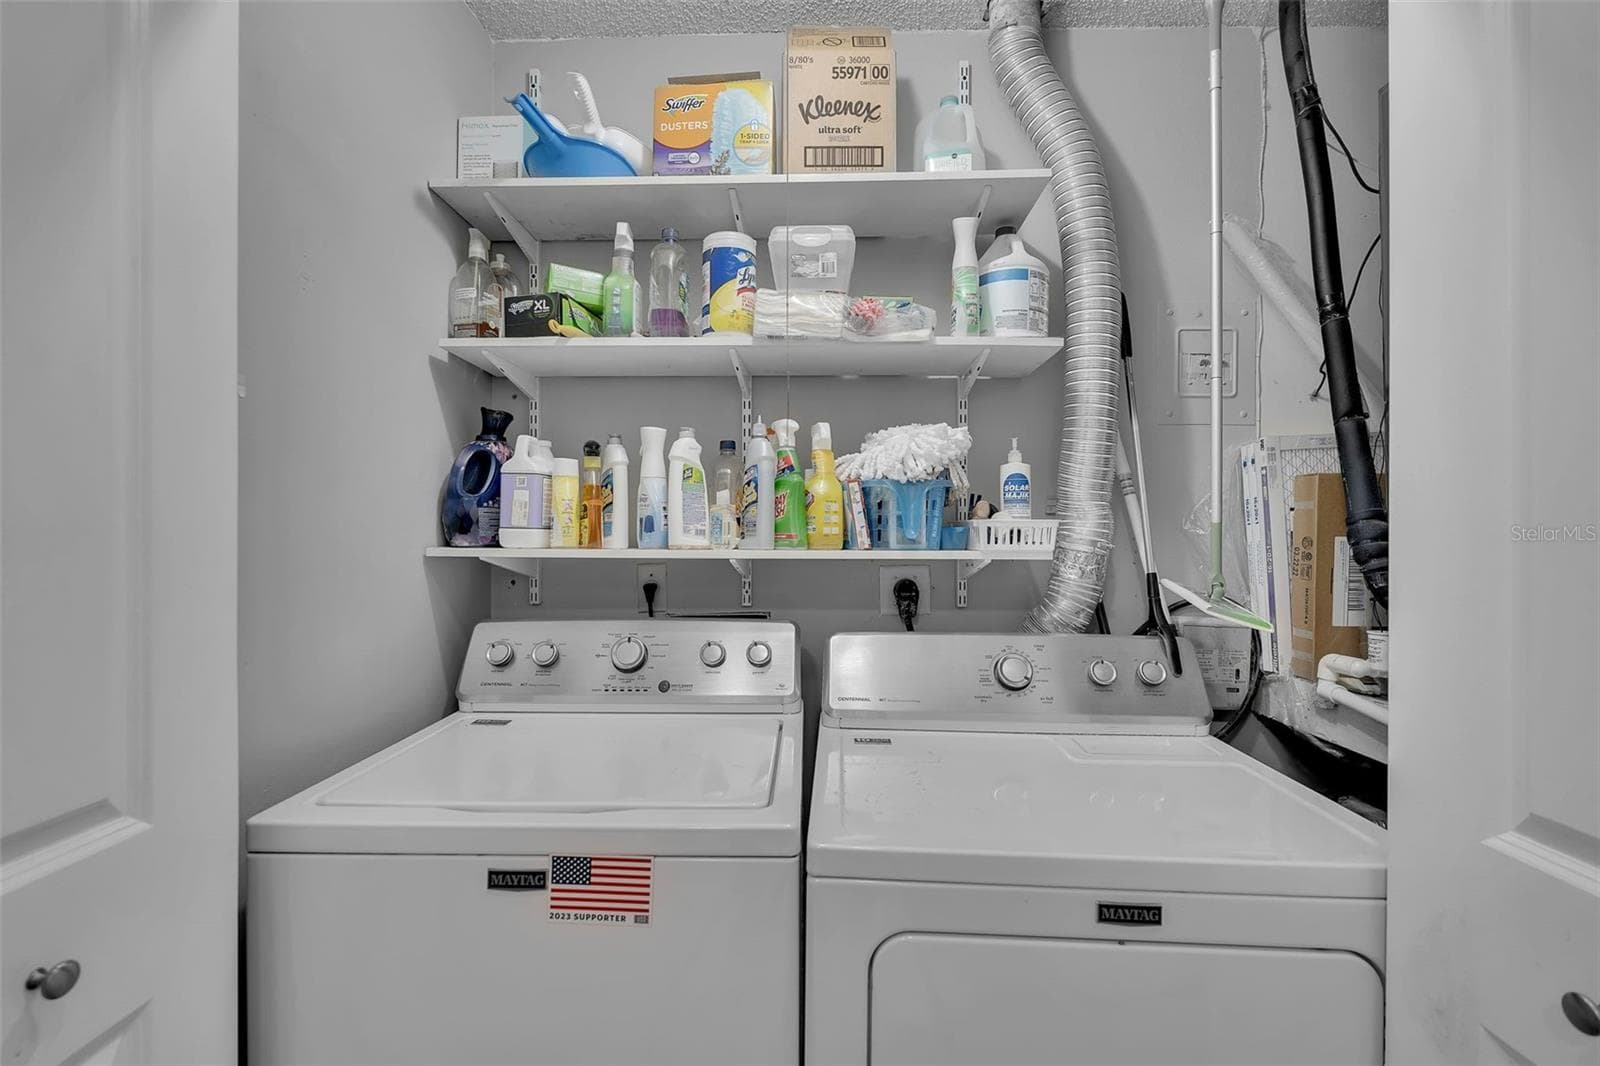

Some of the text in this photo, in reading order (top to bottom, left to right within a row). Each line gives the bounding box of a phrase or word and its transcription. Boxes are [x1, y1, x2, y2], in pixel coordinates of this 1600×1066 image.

[848, 56, 871, 64] 36000
[831, 66, 889, 80] 55971 00
[662, 97, 705, 113] Swiffer
[798, 95, 881, 125] Kleenex
[660, 120, 709, 132] DUSTERS
[818, 125, 862, 134] ultra soft
[533, 299, 550, 310] XL
[490, 874, 545, 887] MAYTAG
[549, 912, 627, 923] 2023 SUPPORTER
[1101, 907, 1159, 921] MAYTAG
